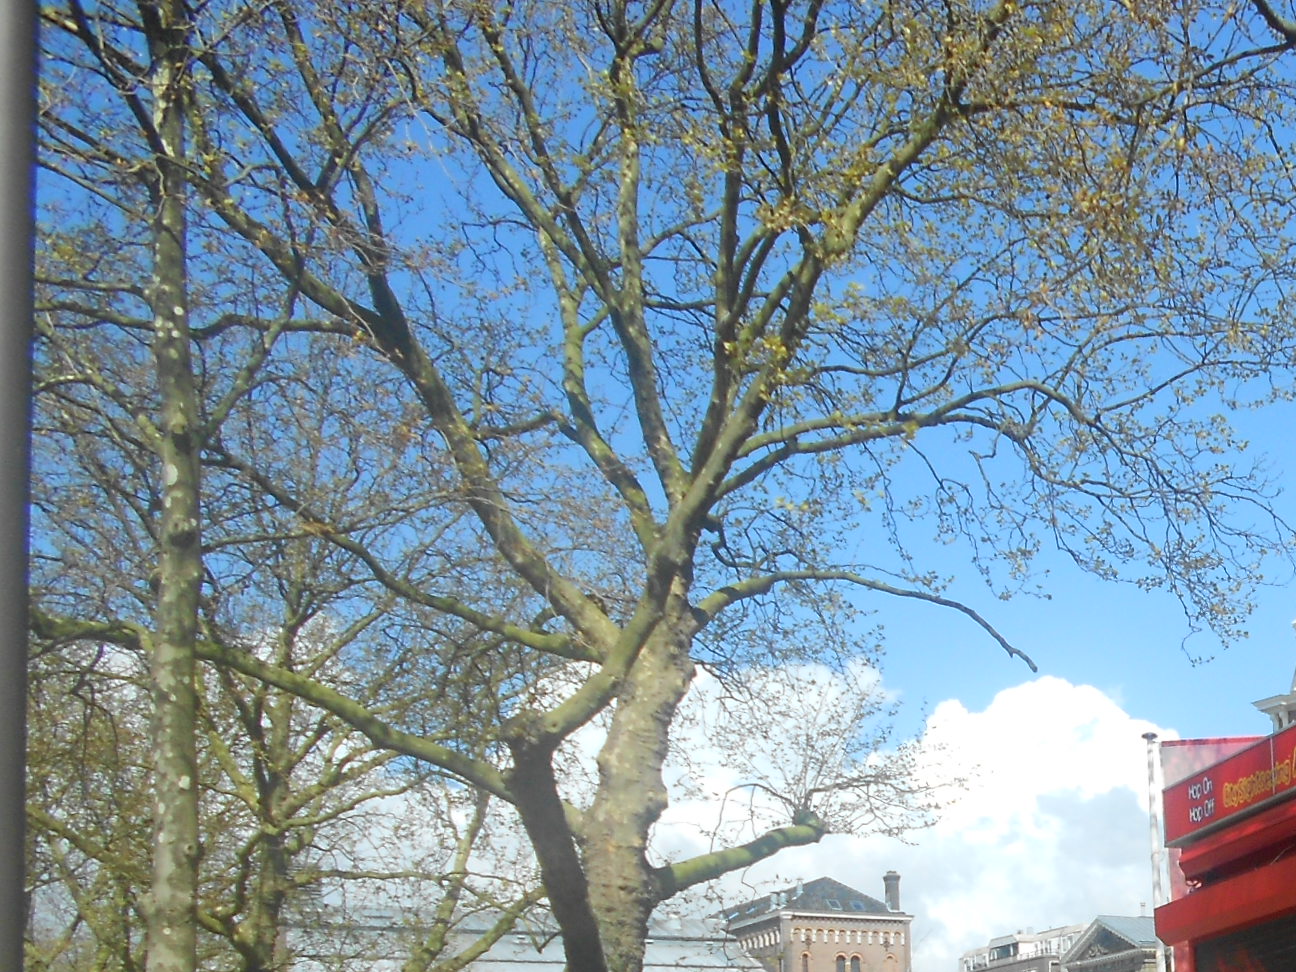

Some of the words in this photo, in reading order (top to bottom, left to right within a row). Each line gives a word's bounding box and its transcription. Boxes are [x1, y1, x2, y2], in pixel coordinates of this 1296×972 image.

[1188, 783, 1202, 800] Hop
[1202, 776, 1213, 795] On
[1189, 805, 1203, 823] Hop
[1203, 797, 1215, 817] Off
